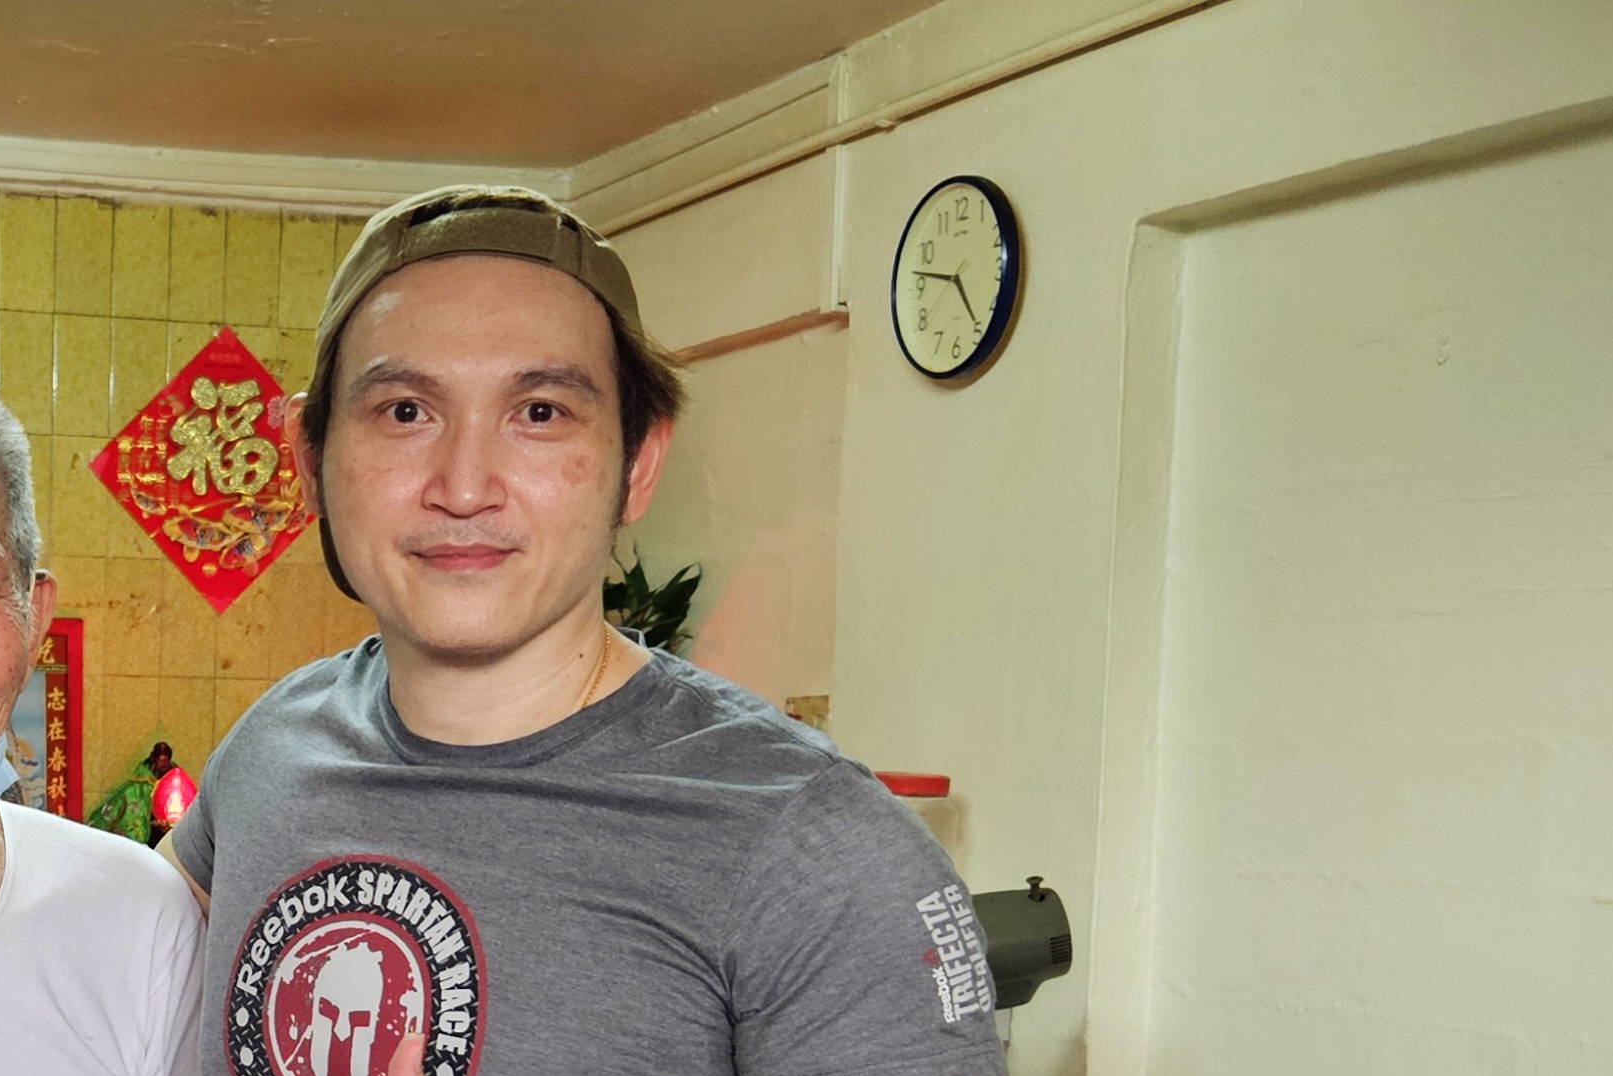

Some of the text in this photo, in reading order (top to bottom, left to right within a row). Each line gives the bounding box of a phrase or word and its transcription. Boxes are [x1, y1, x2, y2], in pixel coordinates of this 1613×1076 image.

[955, 196, 969, 221] 12
[980, 199, 984, 223] 1
[938, 211, 949, 236] 11
[921, 240, 934, 264] 10
[915, 276, 926, 300] 9
[918, 308, 927, 331] 8
[934, 331, 943, 354] 7
[972, 321, 983, 346] 5
[951, 336, 961, 358] 6
[166, 375, 280, 497] 福
[235, 868, 473, 1056] Reebok SPARTAN RACE
[915, 889, 980, 1022] TRIFECTA
[932, 966, 956, 1023] Reebok
